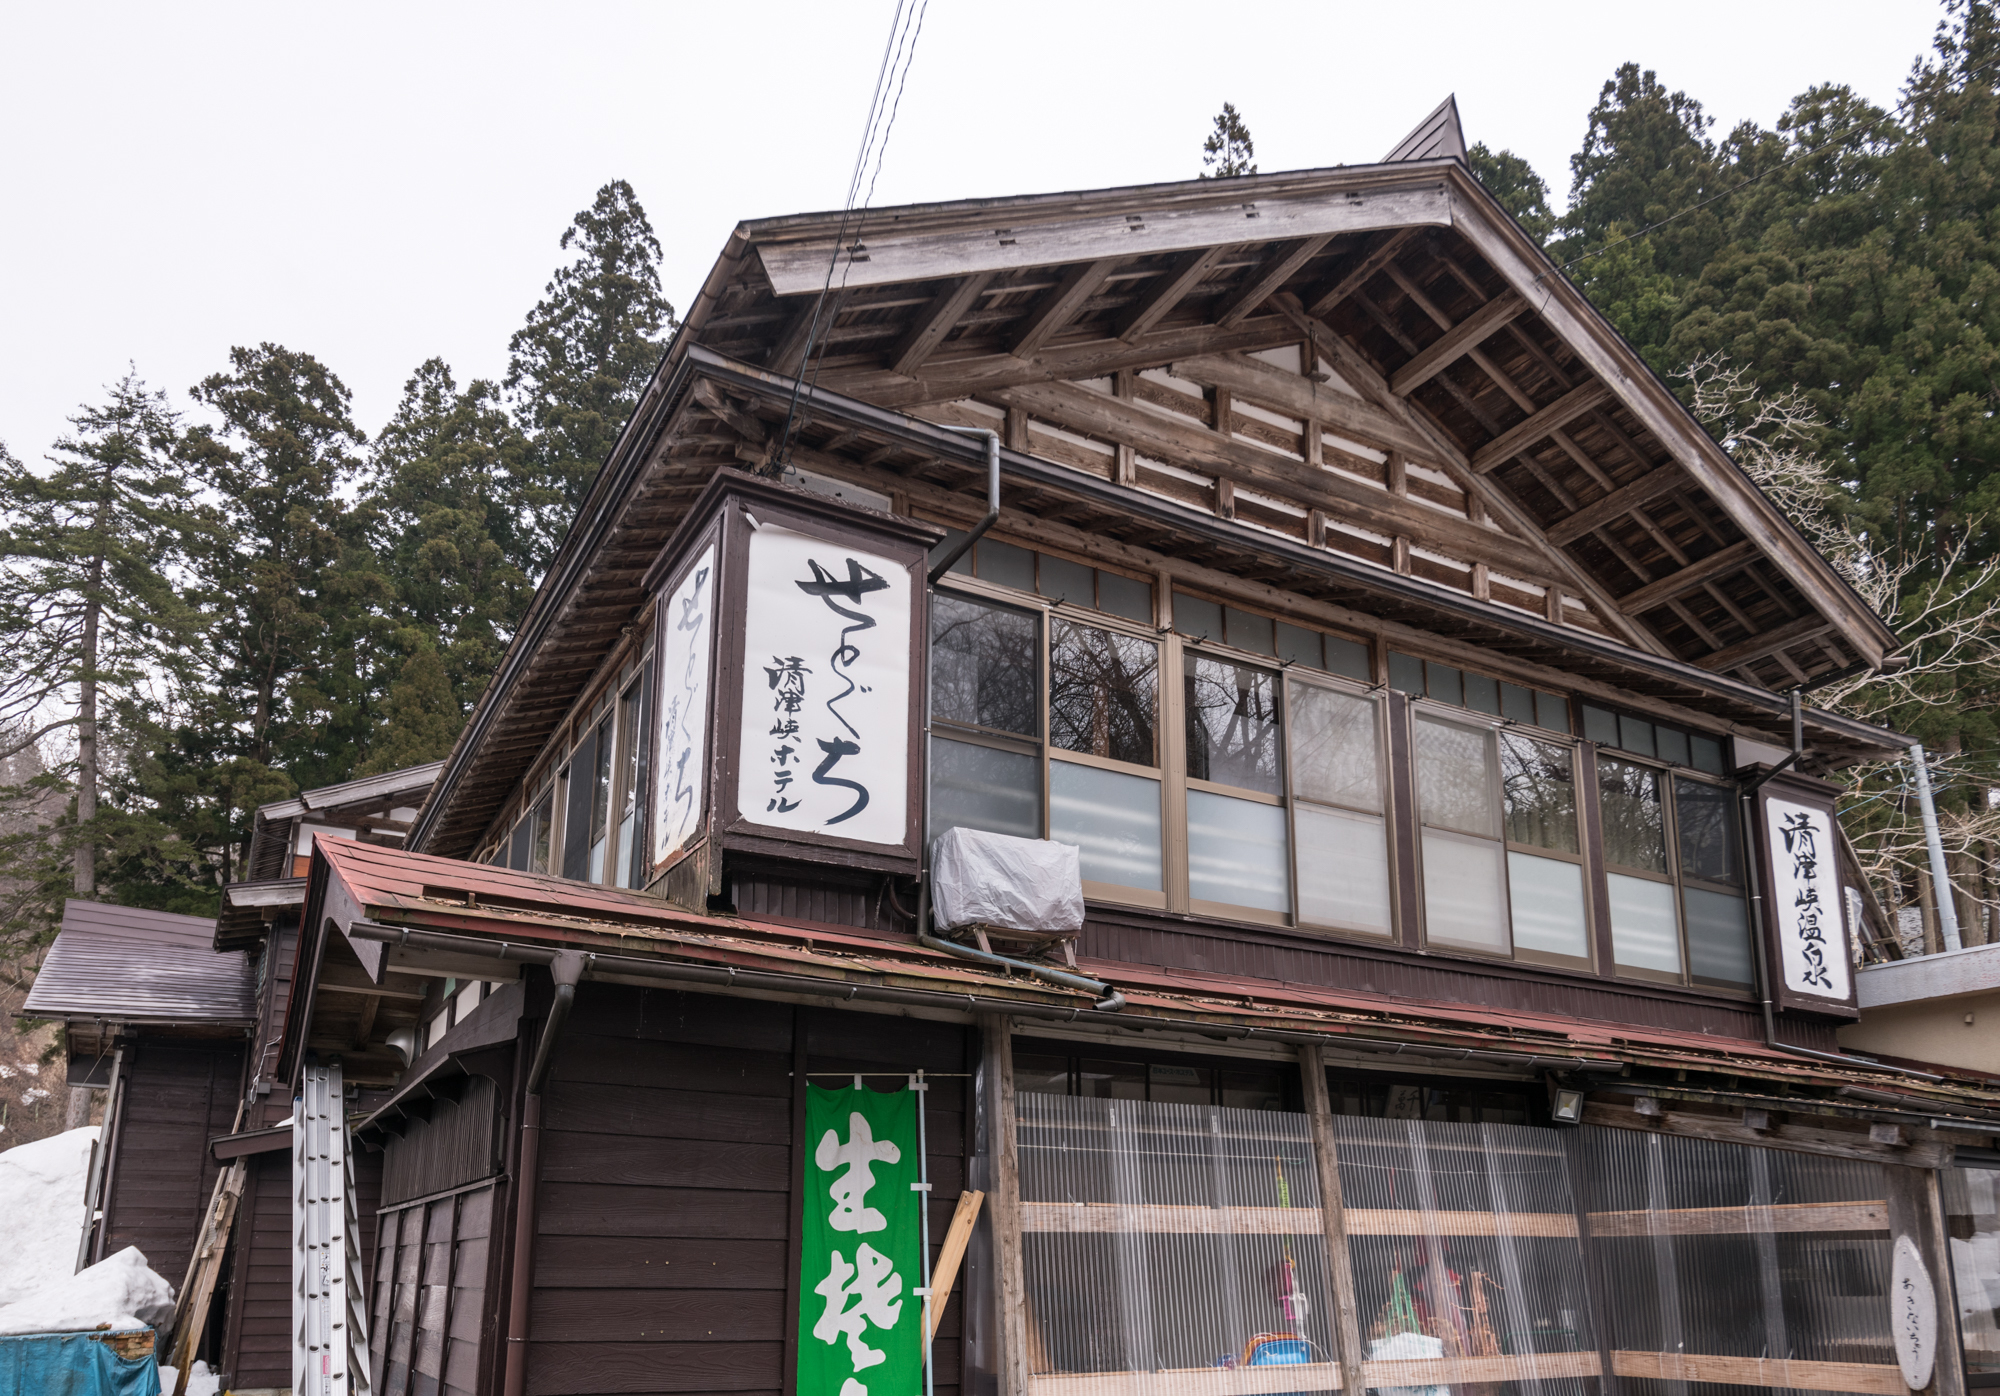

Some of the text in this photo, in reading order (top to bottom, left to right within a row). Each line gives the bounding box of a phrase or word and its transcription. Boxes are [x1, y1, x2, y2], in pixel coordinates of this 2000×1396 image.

[763, 655, 813, 813] 清津峡ホテル
[1778, 812, 1833, 989] 清津峡温泉
